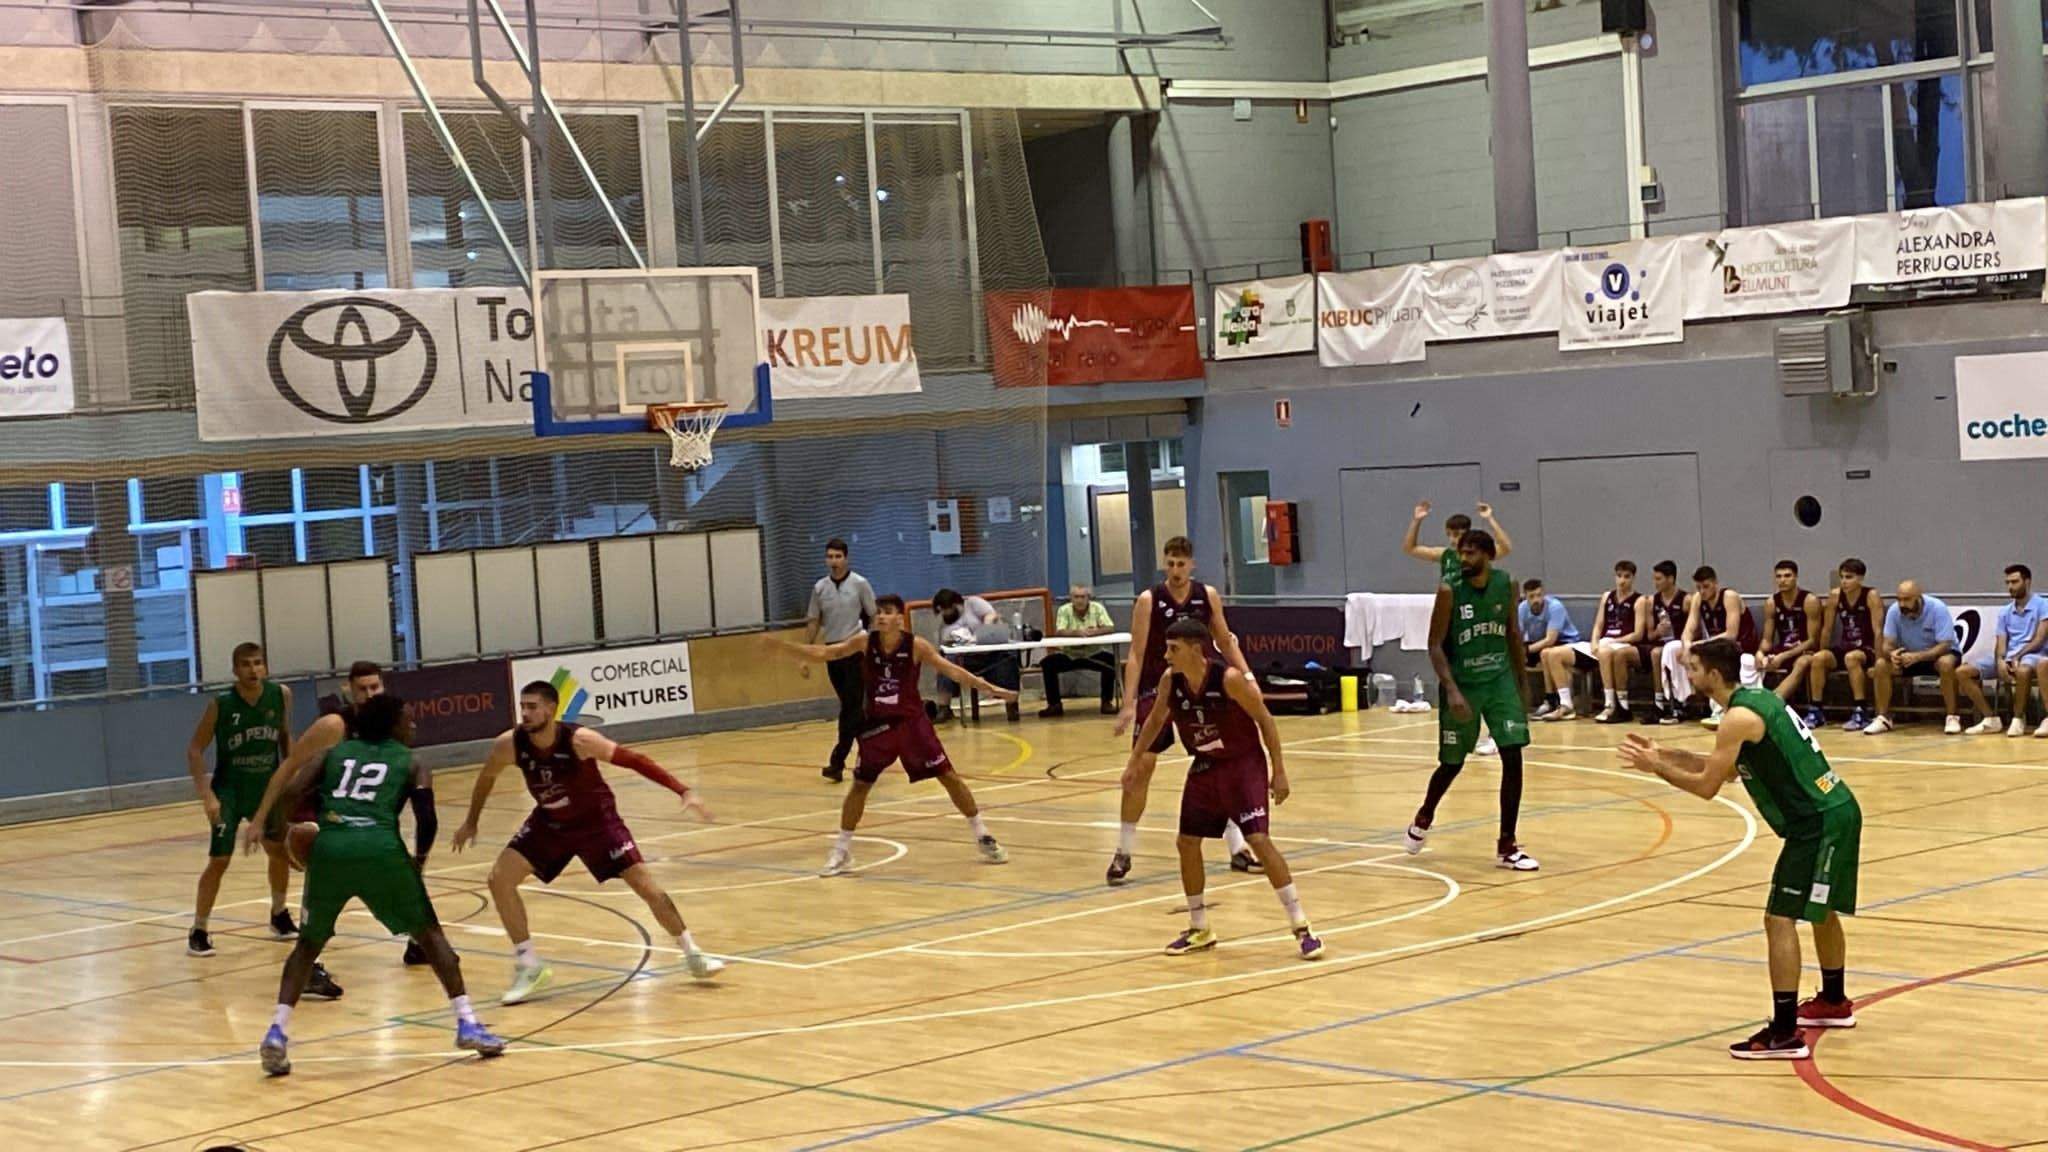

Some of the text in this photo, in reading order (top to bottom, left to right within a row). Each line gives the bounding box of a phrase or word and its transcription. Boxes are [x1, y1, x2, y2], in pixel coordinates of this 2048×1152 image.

[1896, 229, 1997, 254] ALEXANDRA
[1896, 251, 2001, 276] PERRUQUERS
[1586, 302, 1649, 330] viajet
[767, 323, 914, 369] KREUM
[1246, 635, 1336, 654] NAYMOTOR
[591, 657, 688, 682] COMERCIAL
[595, 685, 688, 711] PINTURES
[231, 712, 241, 726] 7
[332, 758, 388, 801] 12
